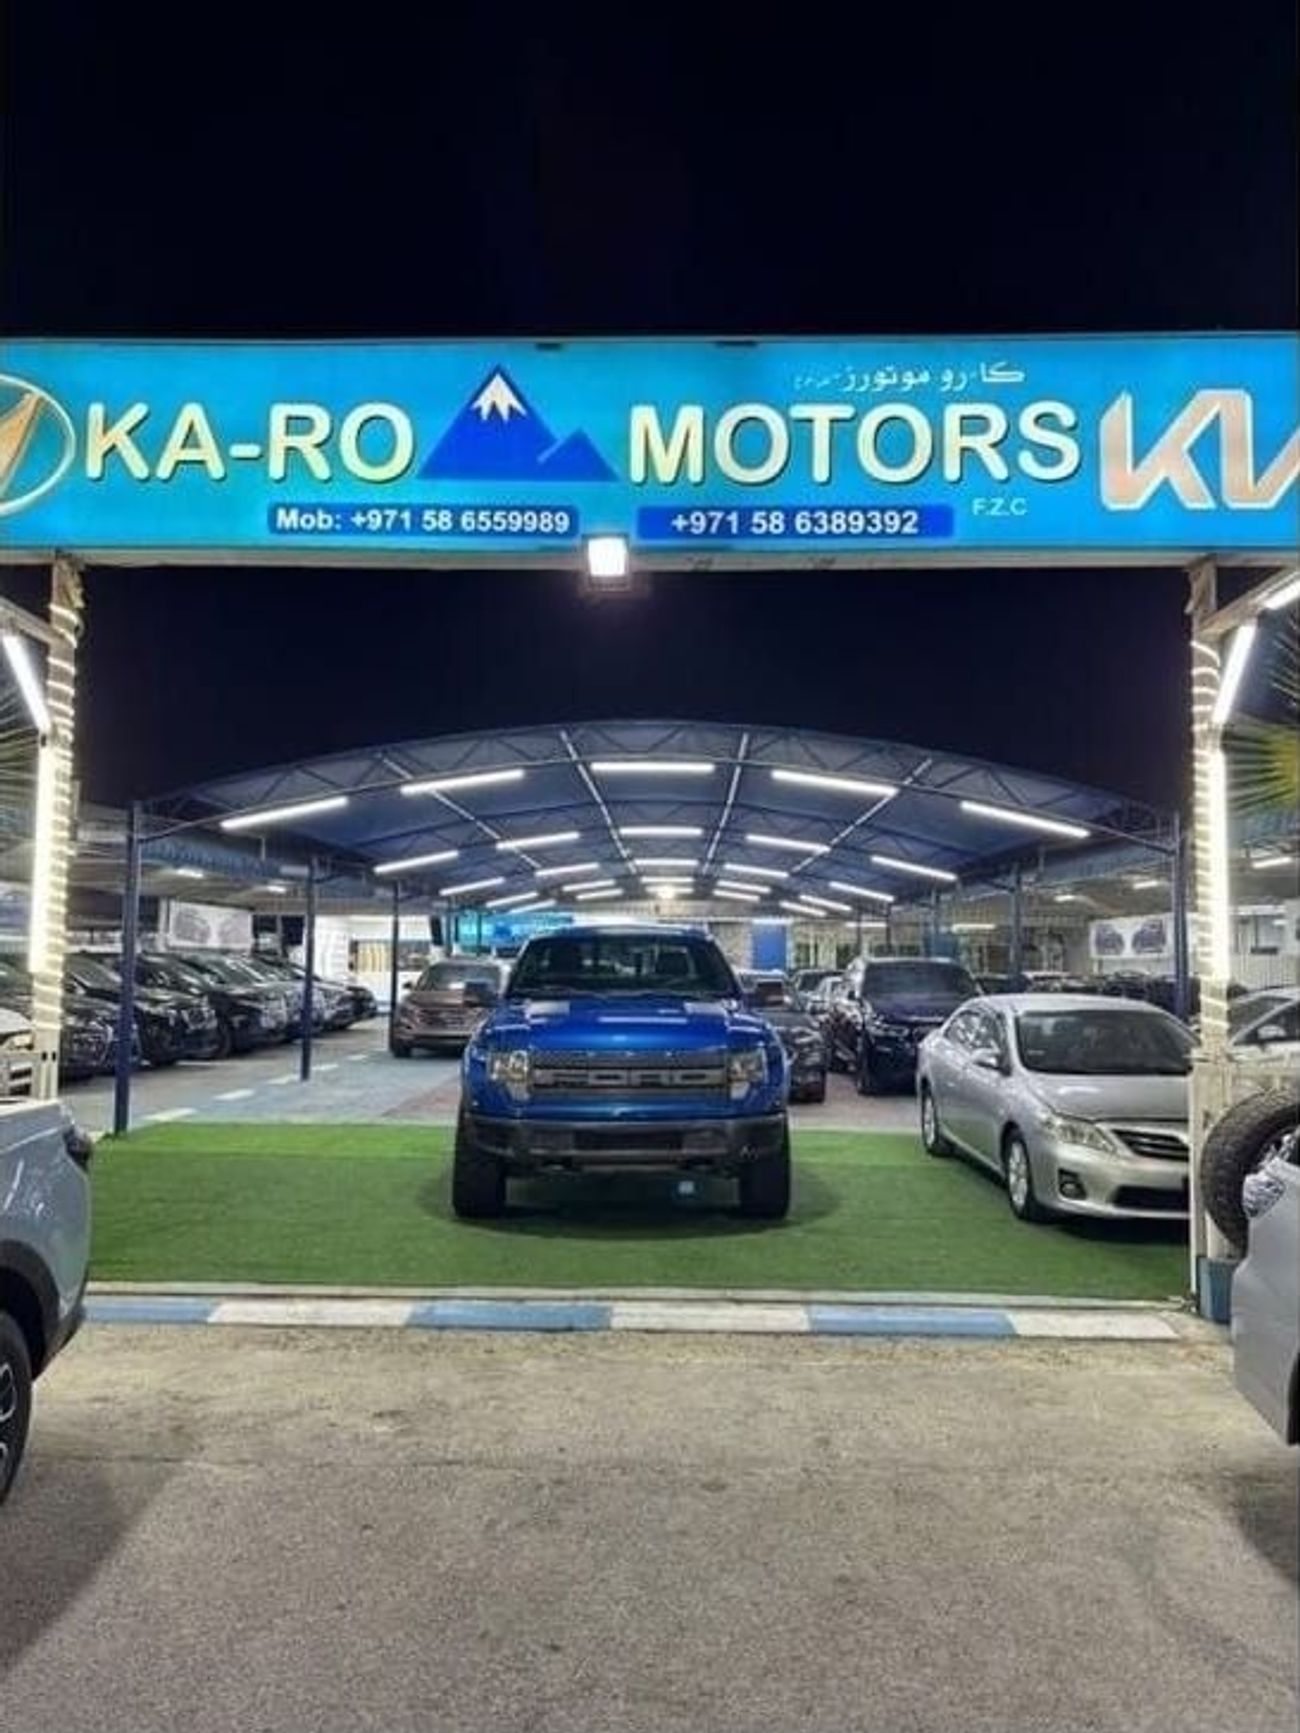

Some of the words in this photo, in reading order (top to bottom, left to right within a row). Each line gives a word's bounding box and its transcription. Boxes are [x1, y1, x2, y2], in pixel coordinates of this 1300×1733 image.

[86, 402, 414, 482] KA-RO
[630, 401, 1081, 486] MOTORS
[276, 508, 341, 529] Mob:
[351, 508, 411, 530] +971
[422, 510, 453, 531] 58
[460, 509, 570, 533] 6559989
[671, 510, 739, 534] +971
[751, 510, 786, 534] 58
[794, 510, 919, 535] 6389392
